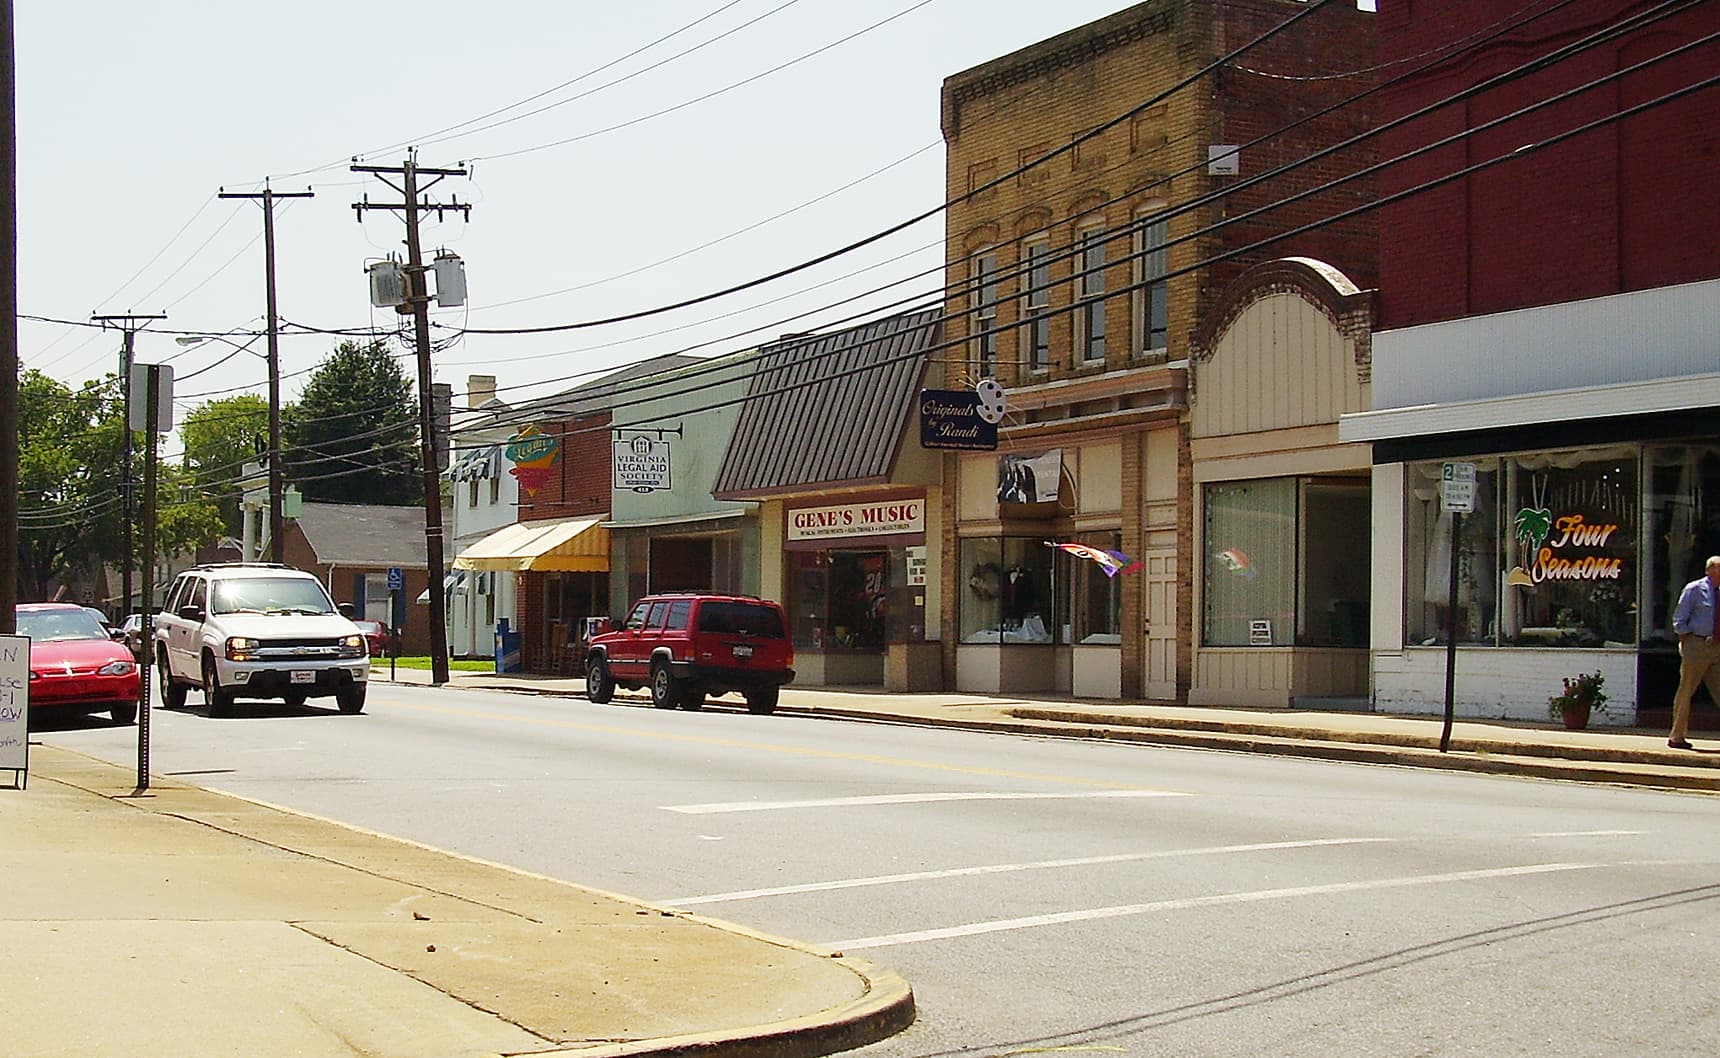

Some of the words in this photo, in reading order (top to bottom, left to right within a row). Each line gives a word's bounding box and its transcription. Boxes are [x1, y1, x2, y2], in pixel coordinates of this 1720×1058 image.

[922, 400, 974, 418] Originals
[936, 421, 979, 438] Randi
[617, 464, 647, 472] LEGAL
[1444, 466, 1452, 479] 2
[794, 510, 853, 528] GENE'S
[861, 504, 918, 524] MUSIC
[1550, 514, 1617, 548] Four
[1532, 547, 1621, 583] Seasons
